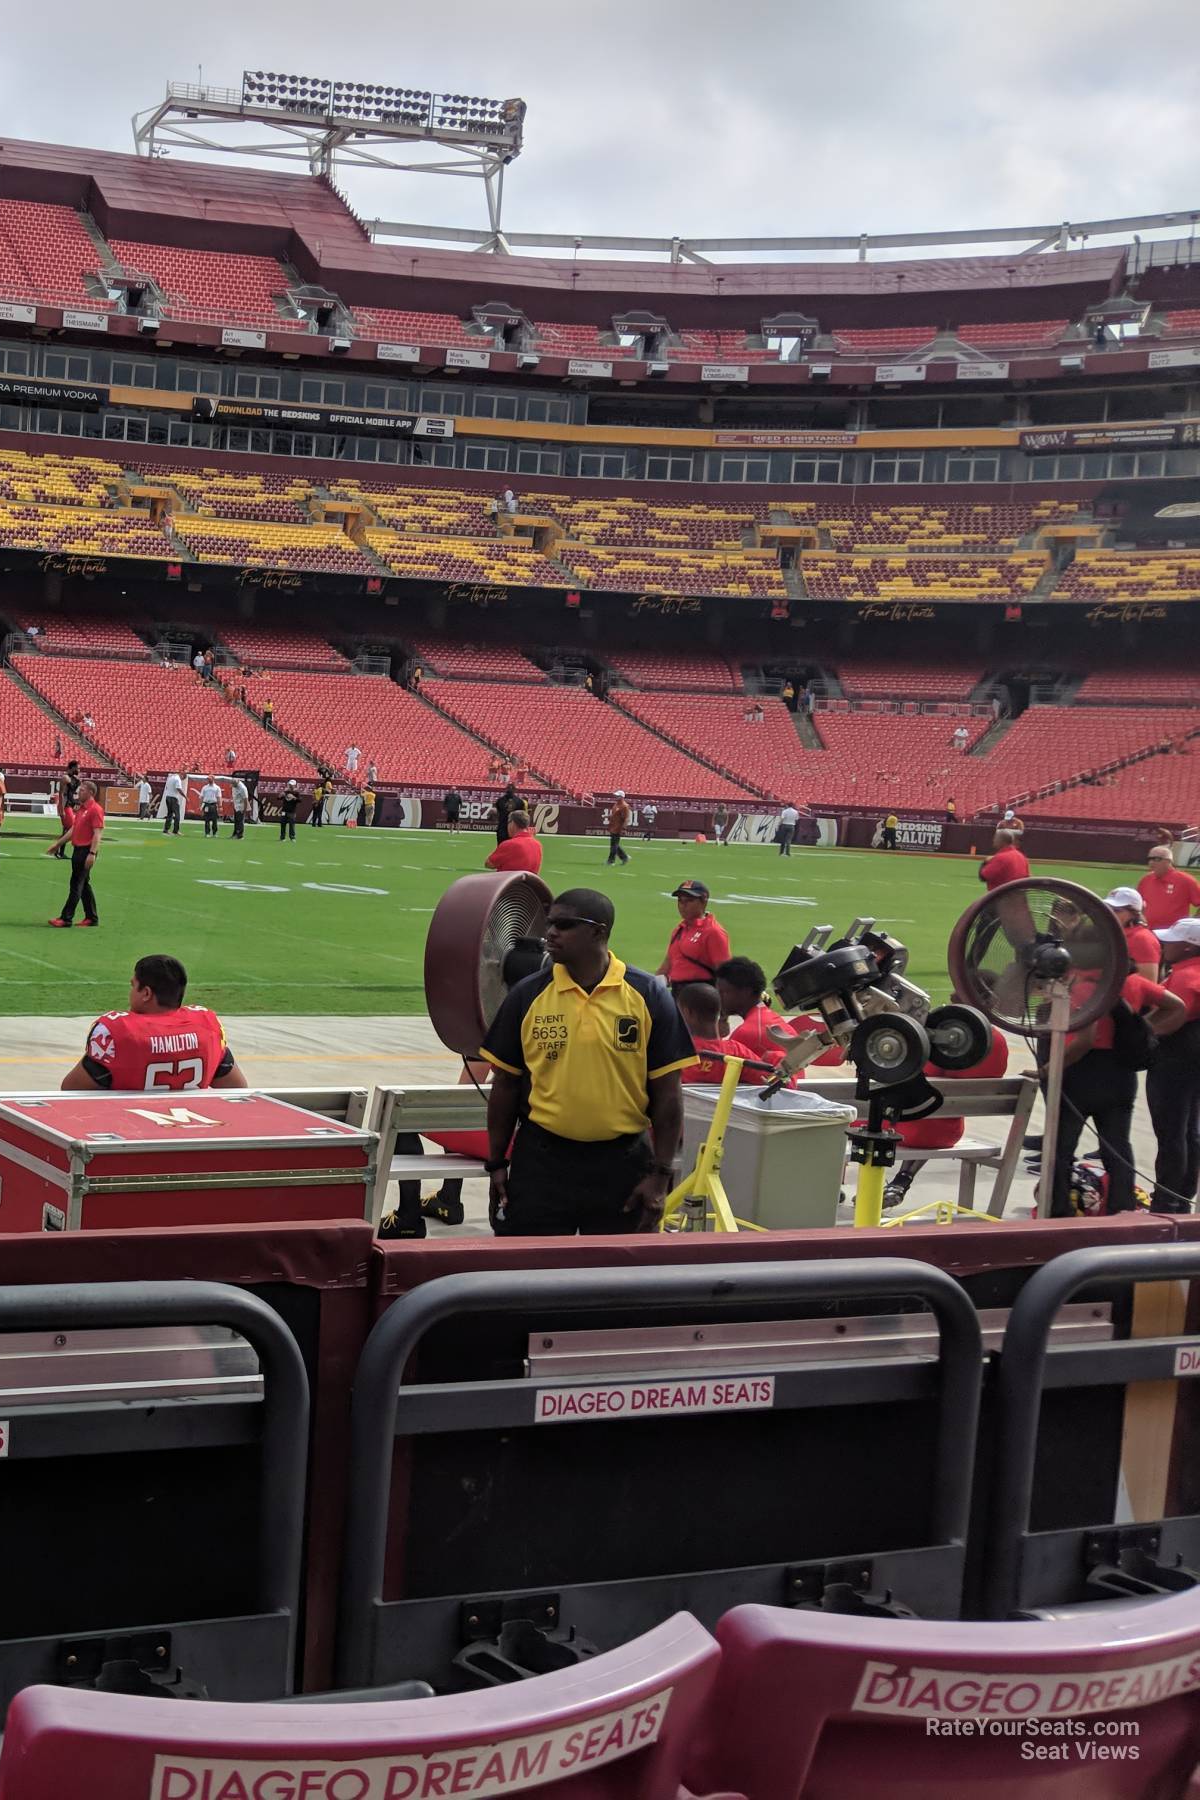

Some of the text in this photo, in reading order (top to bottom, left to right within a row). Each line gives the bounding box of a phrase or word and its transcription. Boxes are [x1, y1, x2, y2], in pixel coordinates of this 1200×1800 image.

[13, 384, 62, 398] PREMIUM
[63, 389, 99, 402] VODKA
[217, 404, 263, 416] DOWNLOAD
[264, 408, 280, 418] THE
[281, 410, 322, 421] REDSKINS
[329, 414, 365, 426] OFFICIAL
[365, 417, 395, 428] MOBILE
[395, 420, 413, 430] APP
[458, 802, 494, 820] 987
[895, 831, 942, 846] SALUTE
[532, 1025, 569, 1041] 5653
[535, 1014, 566, 1034] EVENT
[150, 1033, 199, 1054] HAMILTON
[538, 1040, 567, 1051] STAFF
[545, 1050, 559, 1061] 49
[541, 1381, 771, 1418] DIAGEO DREAM SEATS
[864, 1671, 1041, 1714] DIAGEO
[1049, 1664, 1181, 1713] DREAM
[383, 1740, 552, 1800] DREAM
[557, 1702, 661, 1770] SEATS
